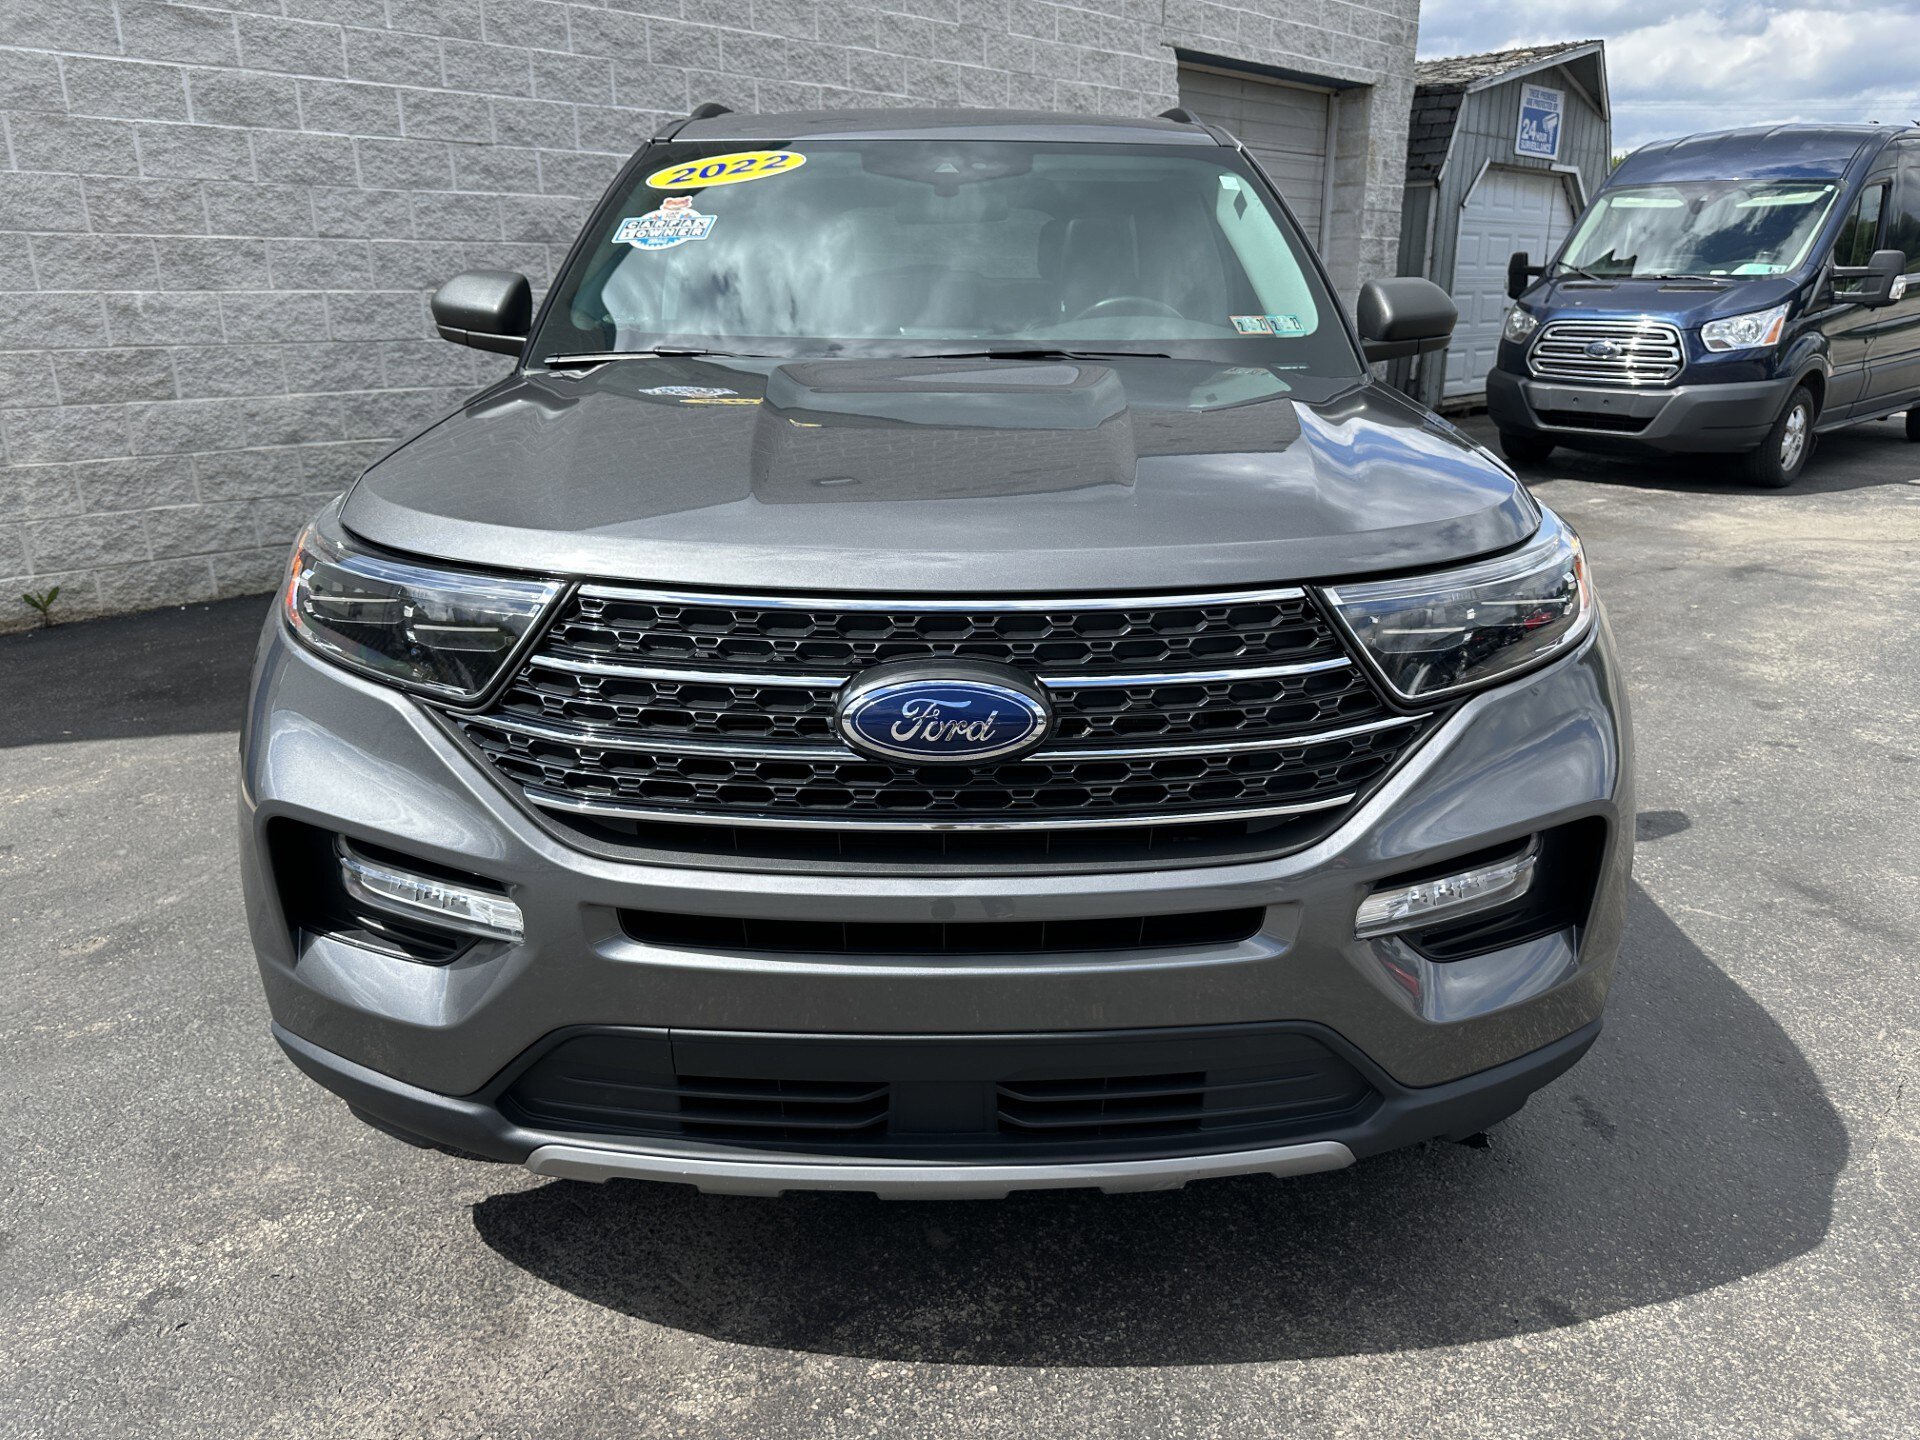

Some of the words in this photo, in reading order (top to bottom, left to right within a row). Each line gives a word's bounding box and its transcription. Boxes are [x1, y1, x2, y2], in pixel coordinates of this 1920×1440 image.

[1521, 118, 1537, 140] 24
[1536, 132, 1548, 142] HOUR
[1520, 139, 1552, 154] SURVEILLANCE
[666, 155, 790, 185] 2022
[626, 219, 706, 229] CARFAX
[635, 228, 705, 237] OWNER
[891, 698, 998, 742] Ford
